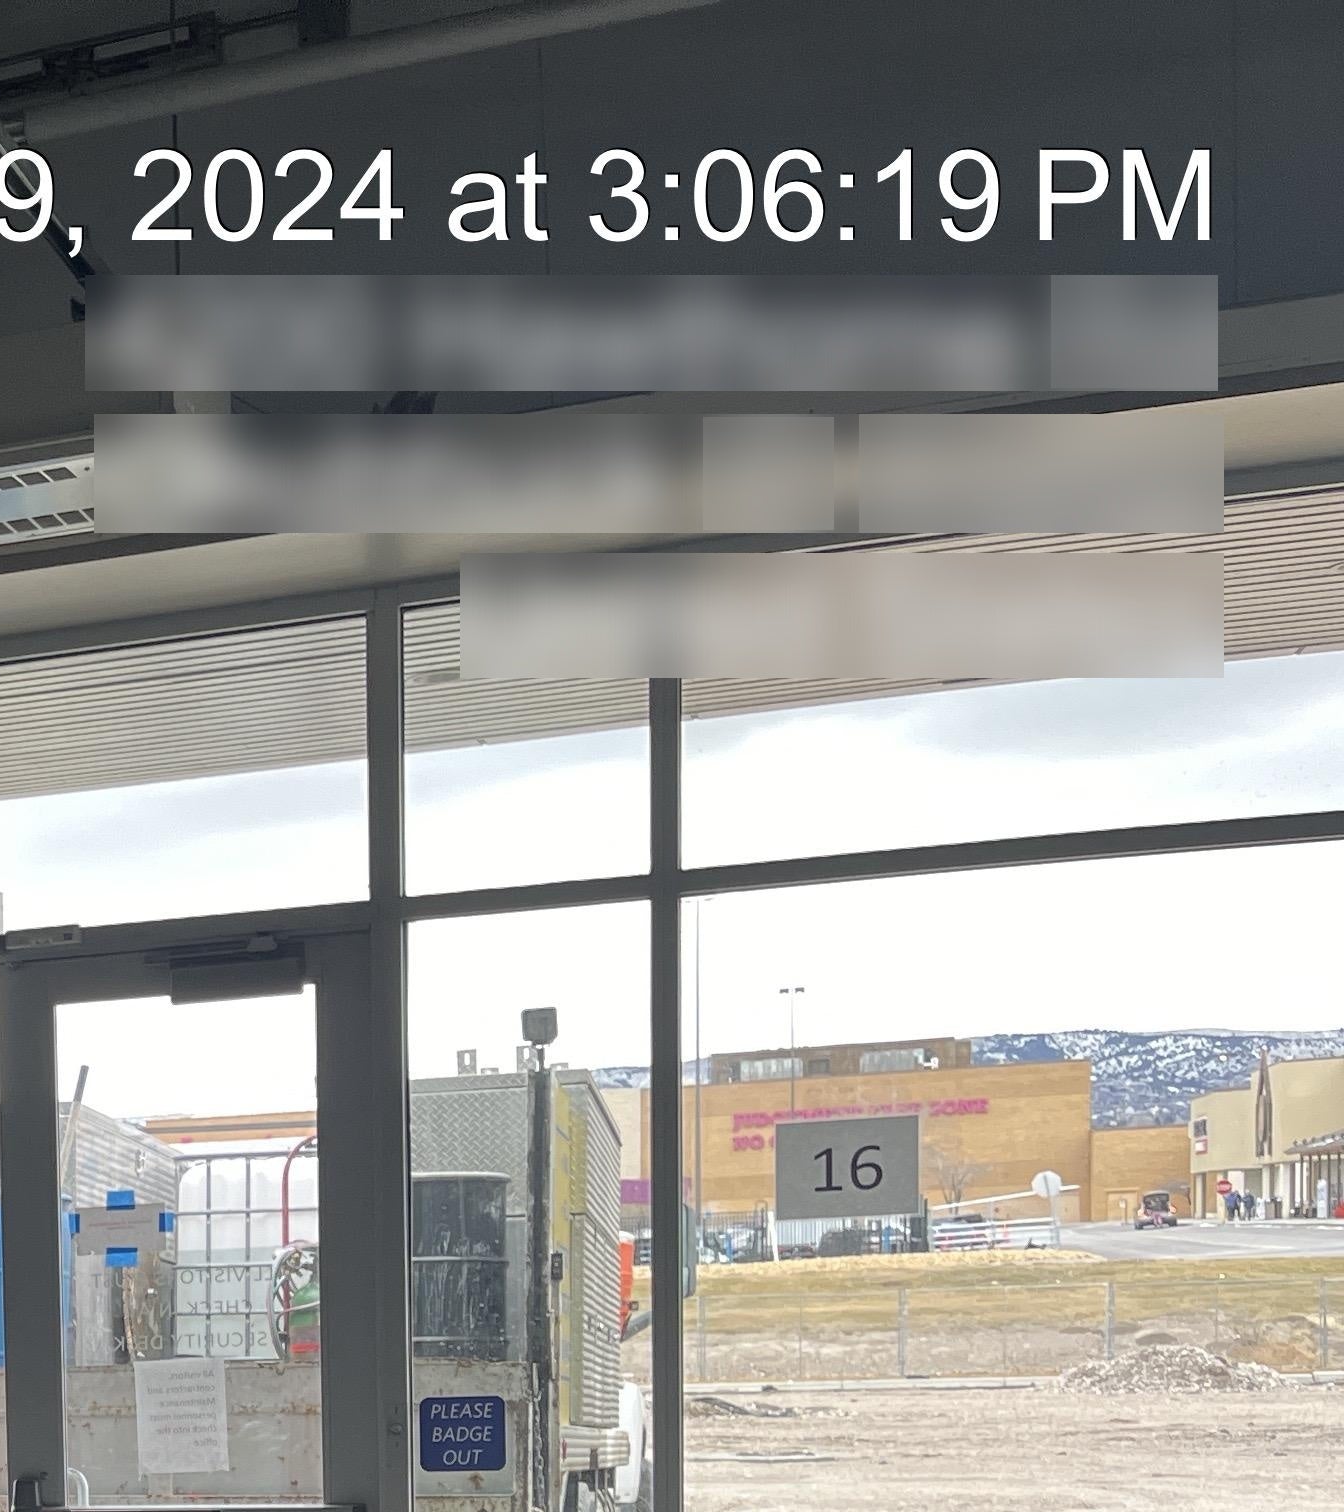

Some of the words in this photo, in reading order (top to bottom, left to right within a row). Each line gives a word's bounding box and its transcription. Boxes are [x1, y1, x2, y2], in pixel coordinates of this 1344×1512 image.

[813, 1144, 884, 1193] 16
[431, 1403, 493, 1419] PLEASE
[432, 1426, 493, 1442] BADGE
[443, 1449, 483, 1465] OUT
